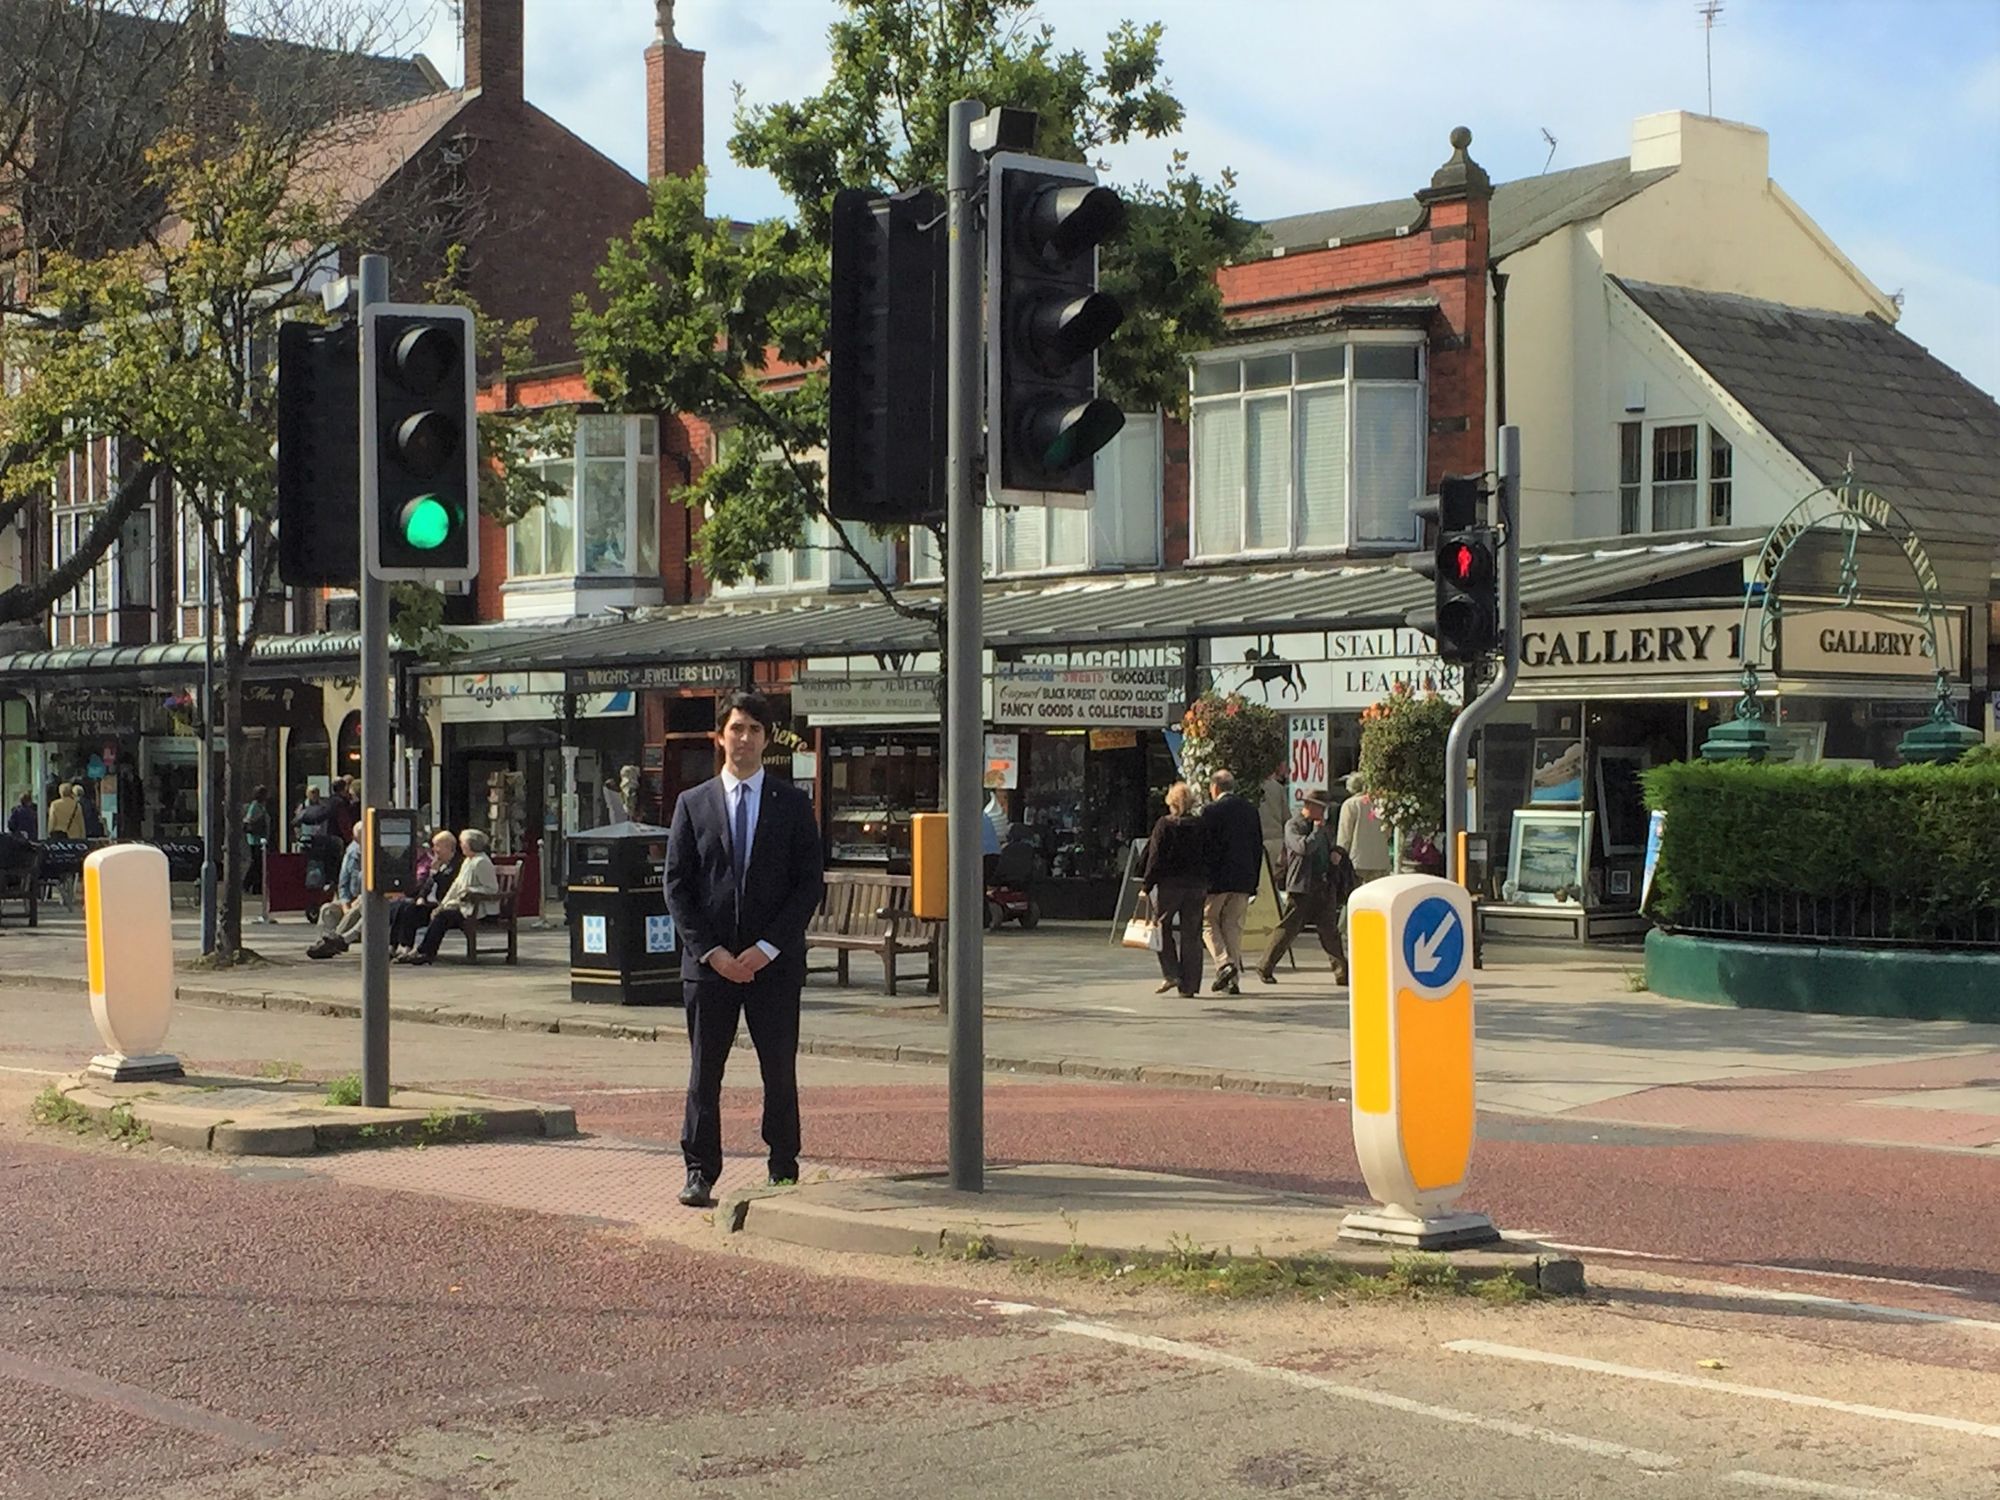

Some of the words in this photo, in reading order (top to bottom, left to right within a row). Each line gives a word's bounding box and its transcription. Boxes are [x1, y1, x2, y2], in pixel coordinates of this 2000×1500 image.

[1334, 633, 1432, 656] STALLIA
[1521, 625, 1717, 667] GALLERY
[1819, 628, 1914, 656] GALLERY
[1022, 647, 1186, 668] TOBACCONIS
[587, 670, 629, 685] WRIGHTS
[641, 665, 698, 683] JEWELLERS
[702, 665, 723, 681] LTD
[1063, 670, 1104, 683] SWEETS
[1043, 688, 1065, 700] BLACK
[1067, 688, 1097, 701] FOREST
[1099, 688, 1133, 701] CUCKOO
[1135, 689, 1167, 702] CLOCKS
[1000, 703, 1034, 717] FANCY
[1038, 704, 1074, 718] GOODS
[1077, 706, 1085, 717] &
[1088, 704, 1164, 719] COLLECTABLES
[1292, 718, 1325, 732] SALE
[1291, 738, 1325, 783] 50%
[644, 875, 664, 886] LITT
